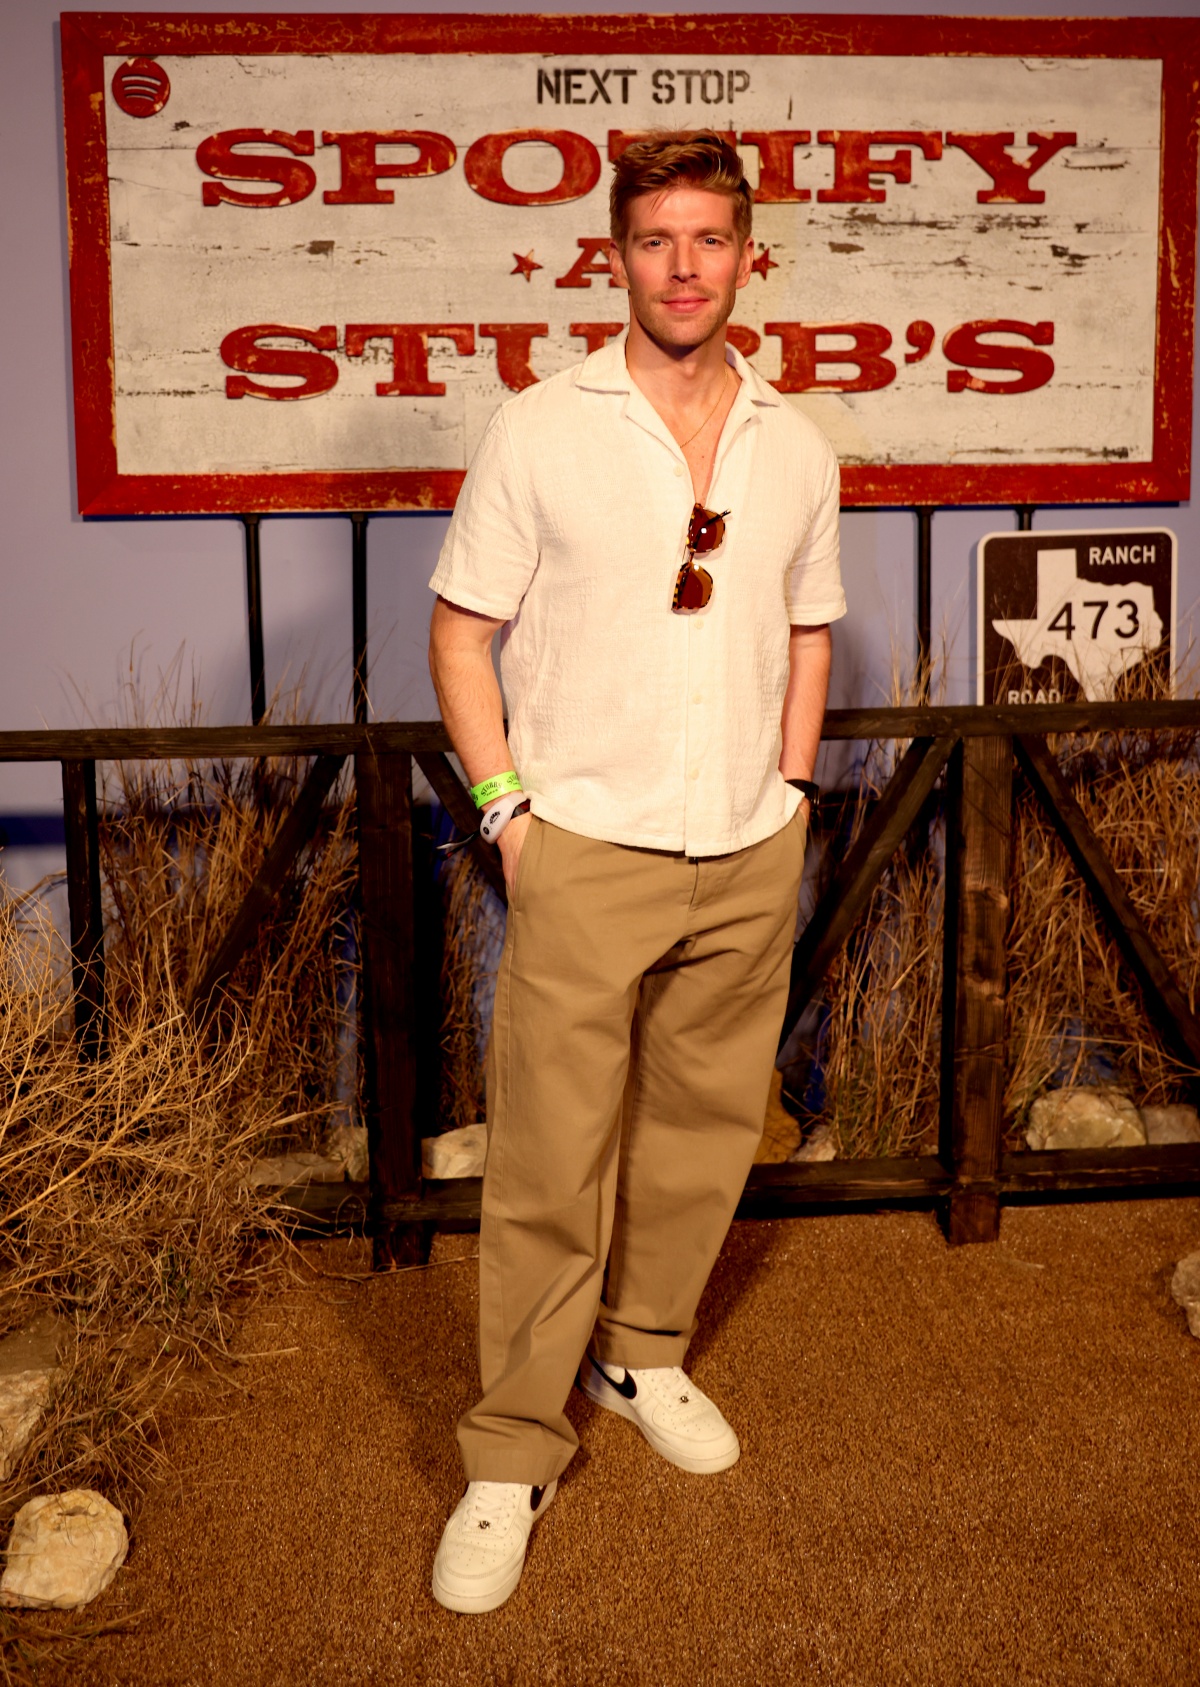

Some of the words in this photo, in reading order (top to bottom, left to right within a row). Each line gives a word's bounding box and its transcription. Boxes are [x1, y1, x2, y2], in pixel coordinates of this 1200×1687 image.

[537, 68, 637, 104] NEXT
[652, 69, 750, 104] STOP
[220, 319, 1055, 401] STUB'S
[1089, 545, 1156, 566] RANCH
[1047, 599, 1140, 641] 473
[1008, 688, 1061, 705] ROAD
